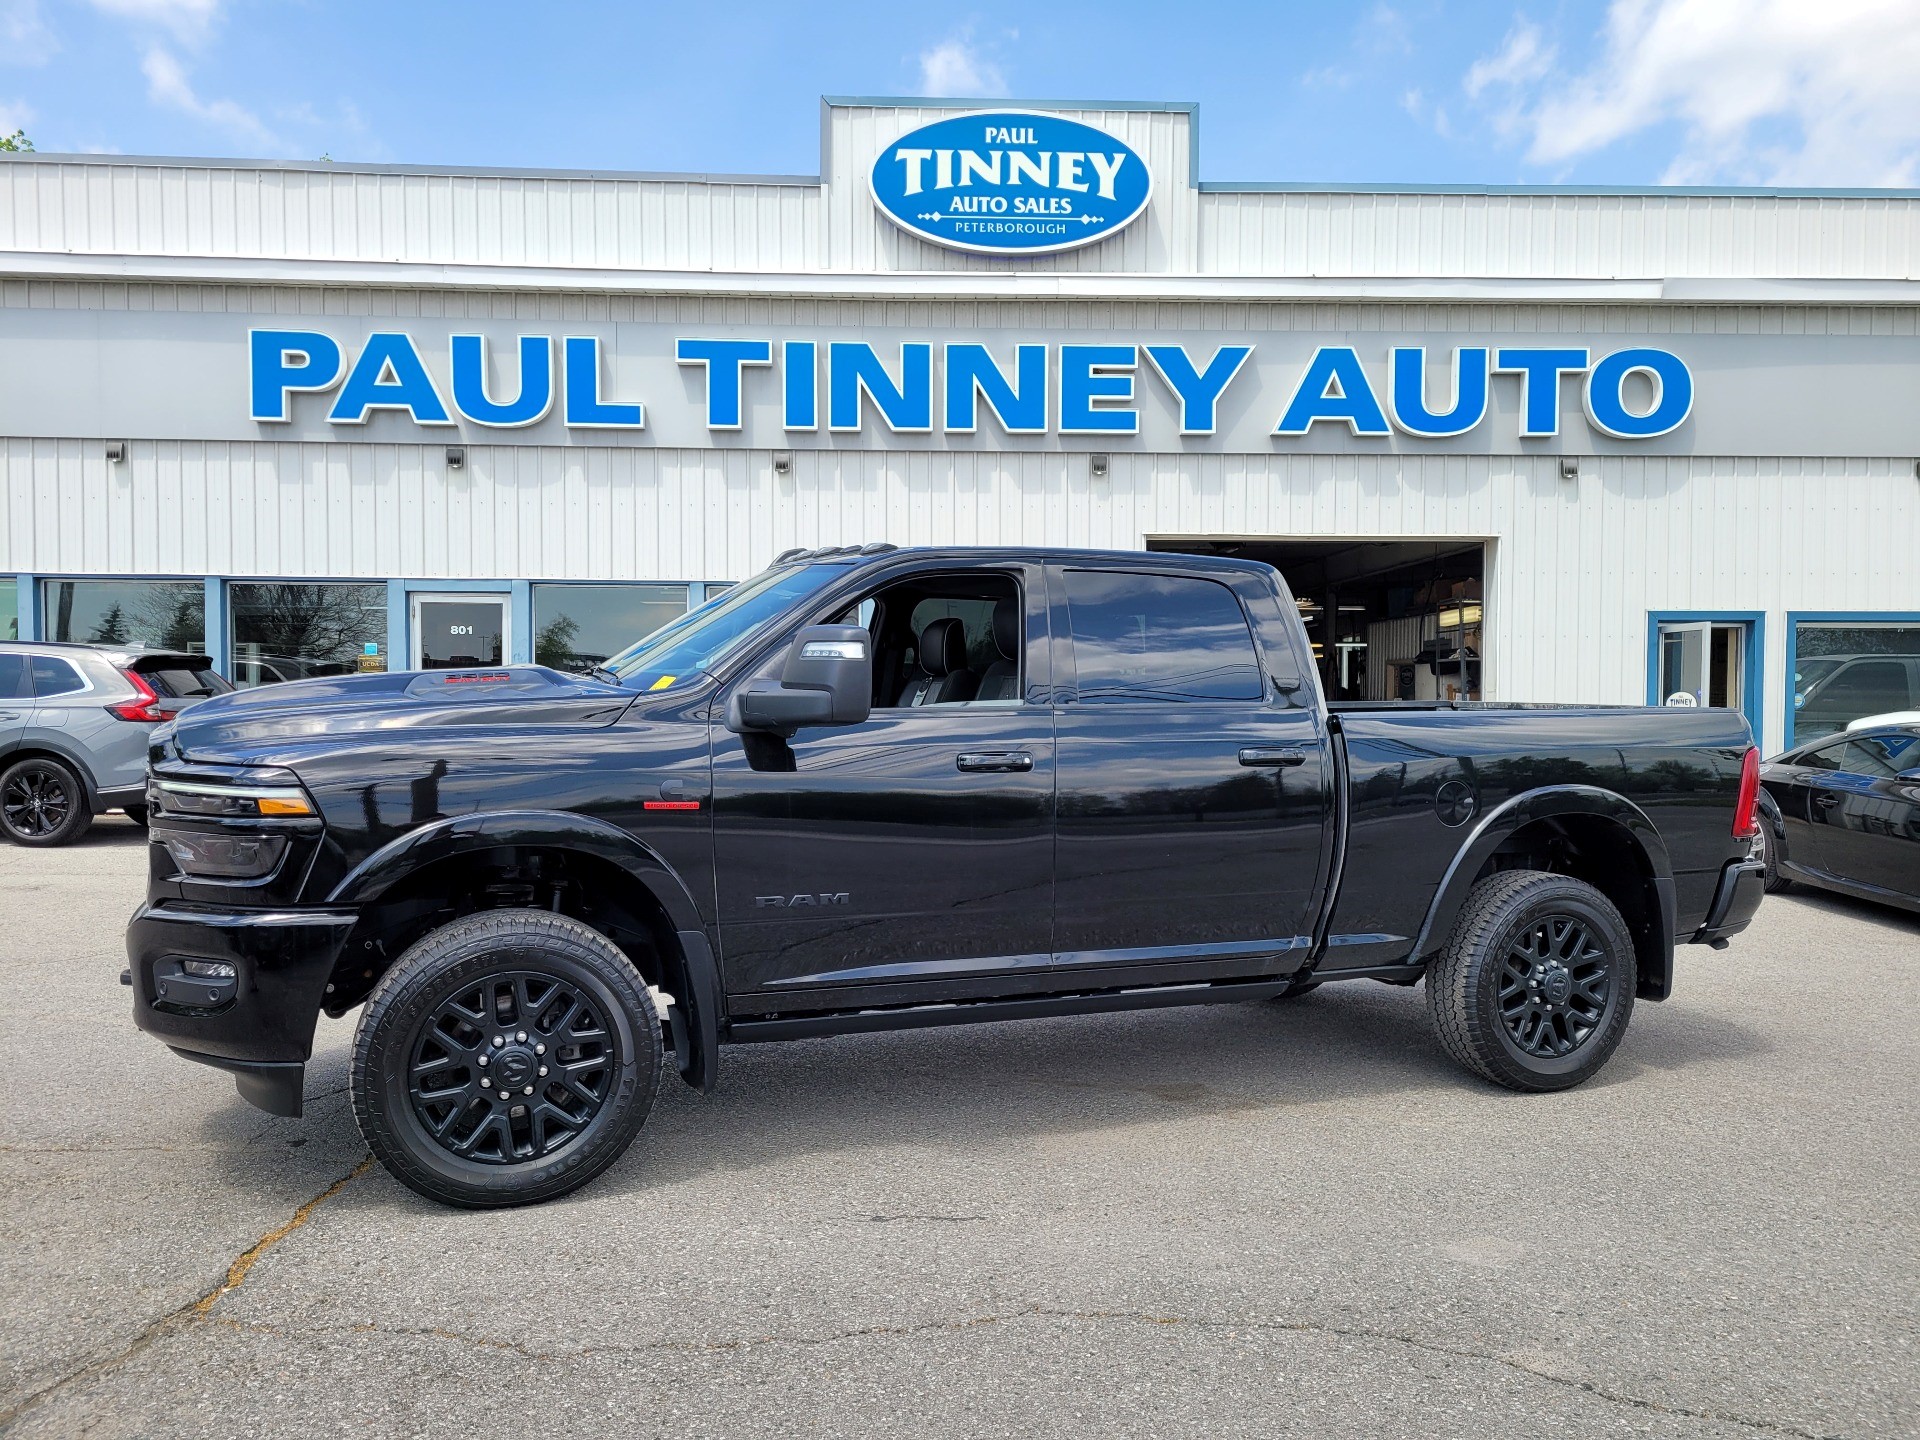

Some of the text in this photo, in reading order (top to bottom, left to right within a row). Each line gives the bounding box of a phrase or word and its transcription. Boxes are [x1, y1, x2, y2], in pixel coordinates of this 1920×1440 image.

[984, 126, 1038, 145] PAUL
[894, 148, 1128, 202] TINNEY
[948, 195, 1073, 215] AUTO SALES
[955, 221, 1067, 235] PETERBOROUGH
[247, 327, 1695, 440] PAUL TINNEY AUTO
[450, 625, 473, 635] 801
[1670, 698, 1693, 707] TINNEY
[755, 892, 850, 909] RAM
